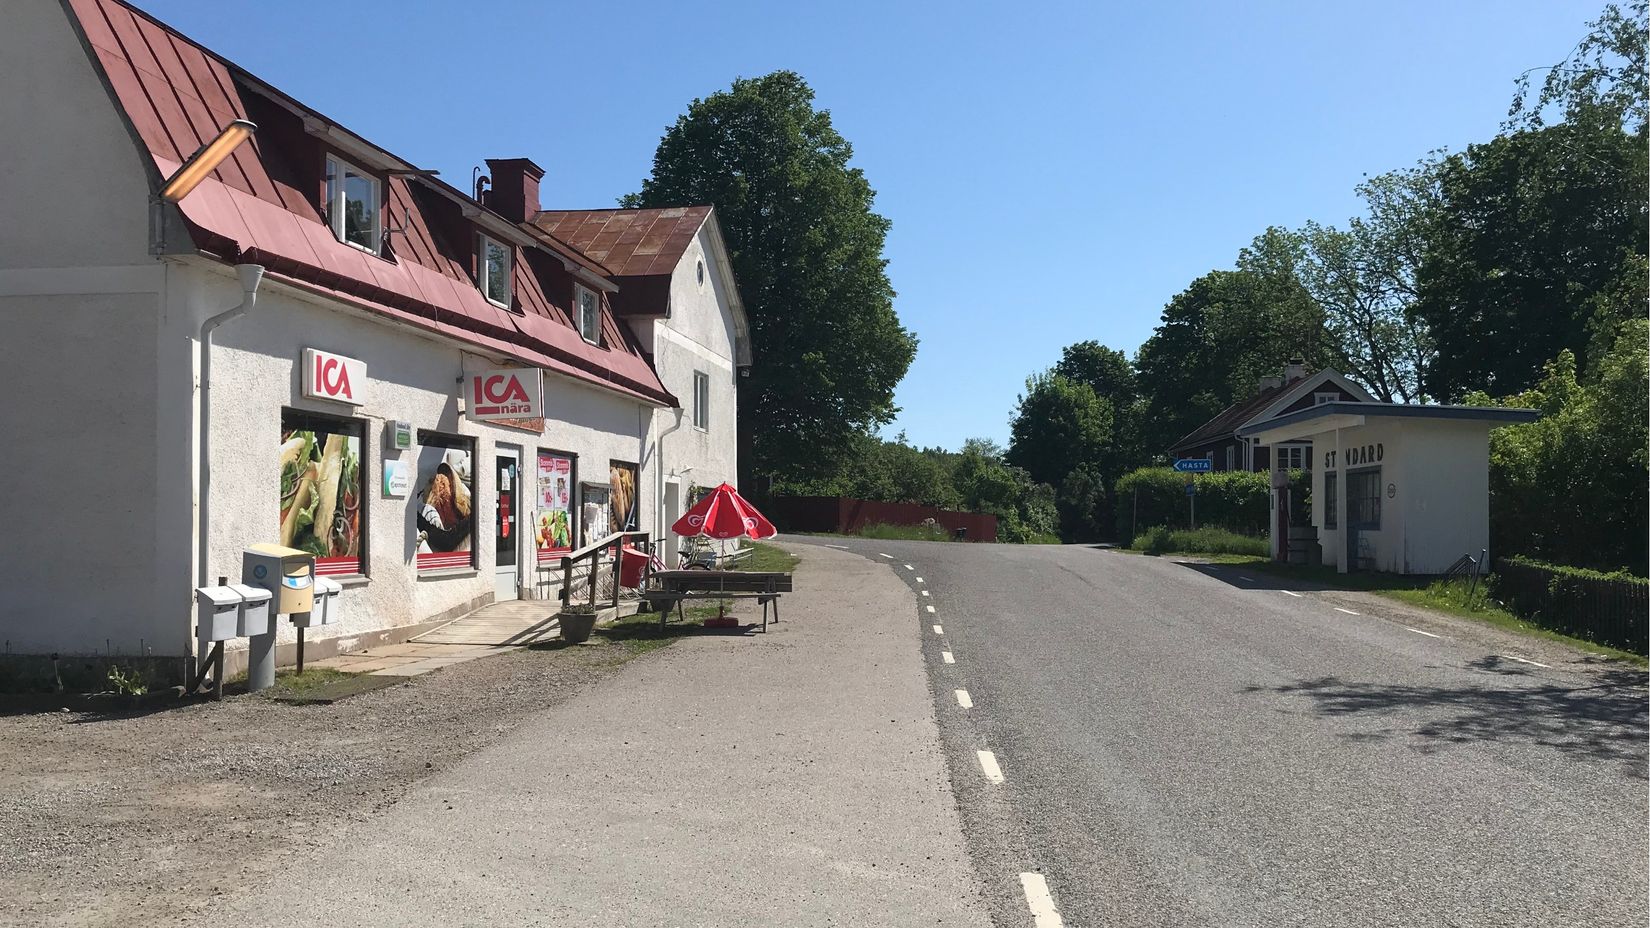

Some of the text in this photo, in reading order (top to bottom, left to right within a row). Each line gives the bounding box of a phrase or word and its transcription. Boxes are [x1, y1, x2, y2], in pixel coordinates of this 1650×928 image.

[316, 355, 352, 399] ICA
[474, 374, 530, 404] ICA
[501, 402, 531, 414] nära
[1325, 443, 1384, 468] STNDARD
